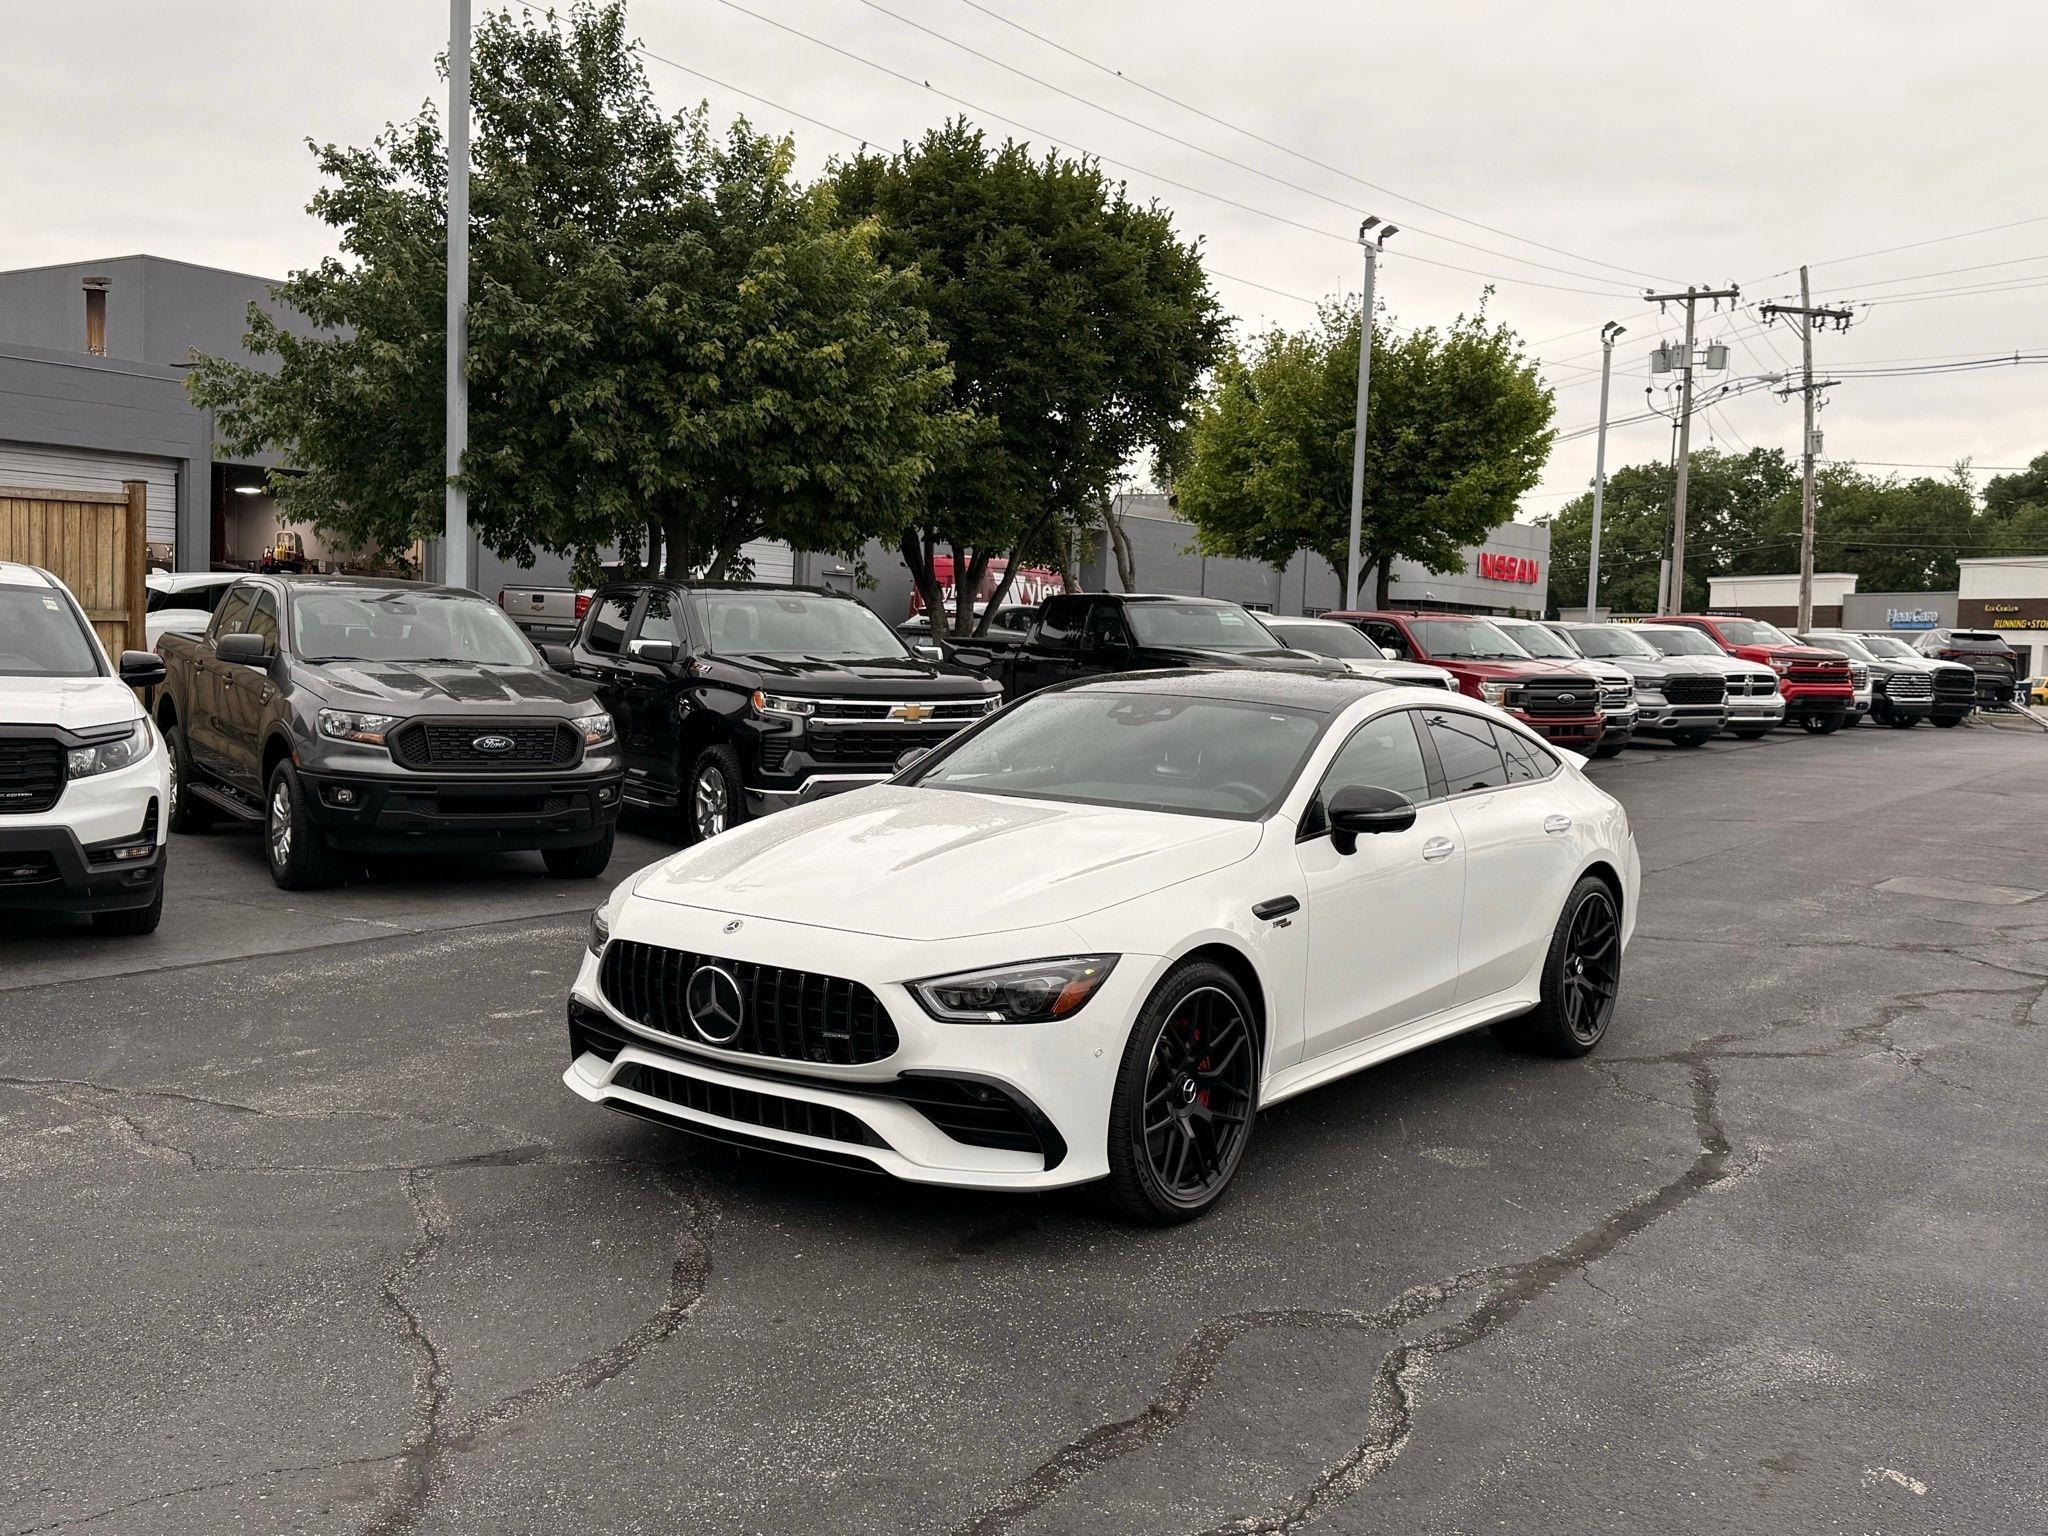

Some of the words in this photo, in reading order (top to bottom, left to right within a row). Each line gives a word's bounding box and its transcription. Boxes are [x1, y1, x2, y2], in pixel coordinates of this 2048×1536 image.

[1479, 552, 1539, 584] NISSAN
[1993, 619, 2027, 629] RUNNING
[483, 738, 506, 748] Ford
